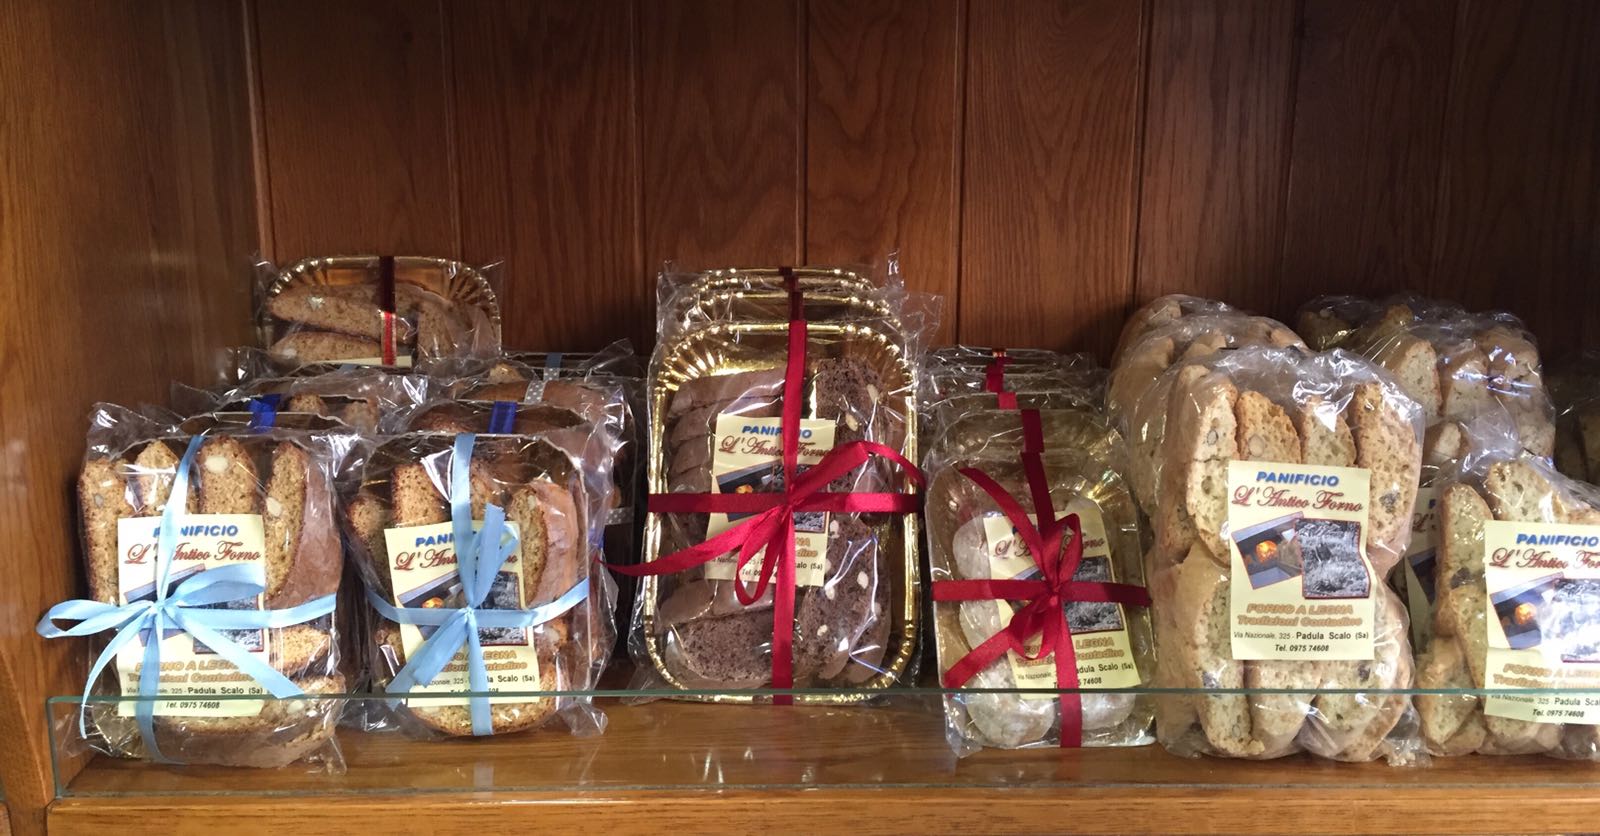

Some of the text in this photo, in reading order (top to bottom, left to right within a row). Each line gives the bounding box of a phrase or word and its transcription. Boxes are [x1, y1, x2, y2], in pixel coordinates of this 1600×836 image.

[742, 425, 812, 439] PANIFIO
[1256, 471, 1339, 487] PANIFICIO
[1312, 490, 1363, 512] Forno
[152, 525, 238, 538] PNIFICIO
[1516, 533, 1599, 547] PANIFICIO
[214, 540, 261, 561] Forno
[1573, 550, 1600, 569] For
[1246, 603, 1353, 615] FORNO A LEGNA
[1237, 615, 1299, 626] Tradizioni
[1296, 631, 1324, 639] Padula
[1329, 631, 1351, 639] Scalo
[1355, 631, 1369, 640] (Sa)
[1075, 637, 1115, 649] LEGNA
[1289, 644, 1306, 652] 0975
[1308, 644, 1329, 652] 74608
[483, 650, 517, 660] EGNA
[185, 660, 196, 671] A
[1098, 663, 1119, 672] Scalo
[497, 674, 519, 683] Scalo
[522, 674, 536, 683] (Sa)
[1083, 677, 1102, 685] 74608
[248, 687, 263, 695] (Sa)
[1554, 697, 1581, 705] Padula
[1585, 697, 1600, 706] Scal
[1546, 709, 1563, 717] 0975
[1564, 710, 1584, 718] 74608
